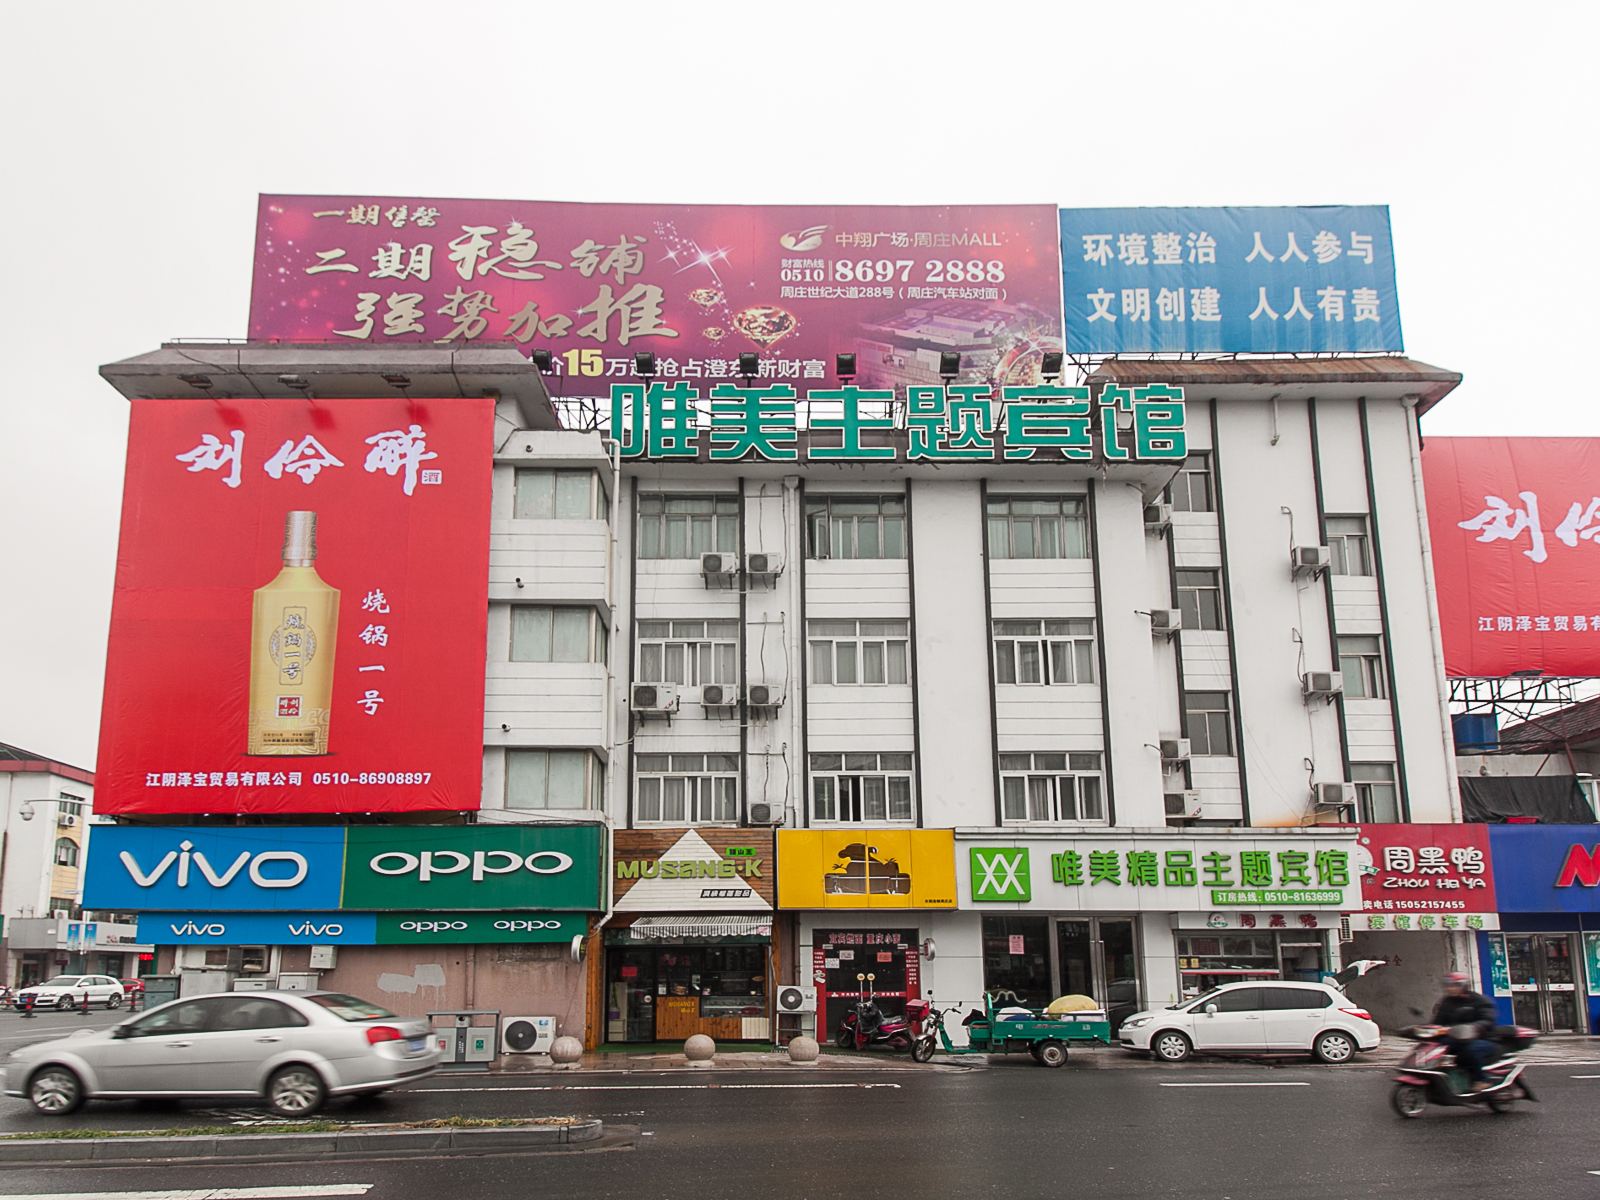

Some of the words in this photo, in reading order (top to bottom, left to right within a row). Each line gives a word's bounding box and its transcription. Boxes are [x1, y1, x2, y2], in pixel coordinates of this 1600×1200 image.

[780, 258, 824, 270] 财富热线
[1082, 231, 1218, 267] 环境整治
[1245, 230, 1373, 265] 人人参与
[780, 269, 824, 282] 0510
[835, 259, 915, 283] 8697
[925, 259, 1006, 283] 2888
[333, 283, 679, 345] 强势加推
[1087, 286, 1223, 323] 文明创建
[1249, 286, 1381, 322] 人人有责
[609, 382, 1188, 461] 唯美主题宾馆
[356, 588, 391, 716] 烧锅一号
[145, 772, 302, 787] 江阴泽宝贸易有限公司
[312, 772, 432, 785] 0510-86908897
[1051, 850, 1350, 887] 唯美精品主题宾馆
[1383, 846, 1486, 875] 周黑鸭
[1395, 900, 1465, 909] 15052157455
[1367, 914, 1484, 931] 宾馆停车场
